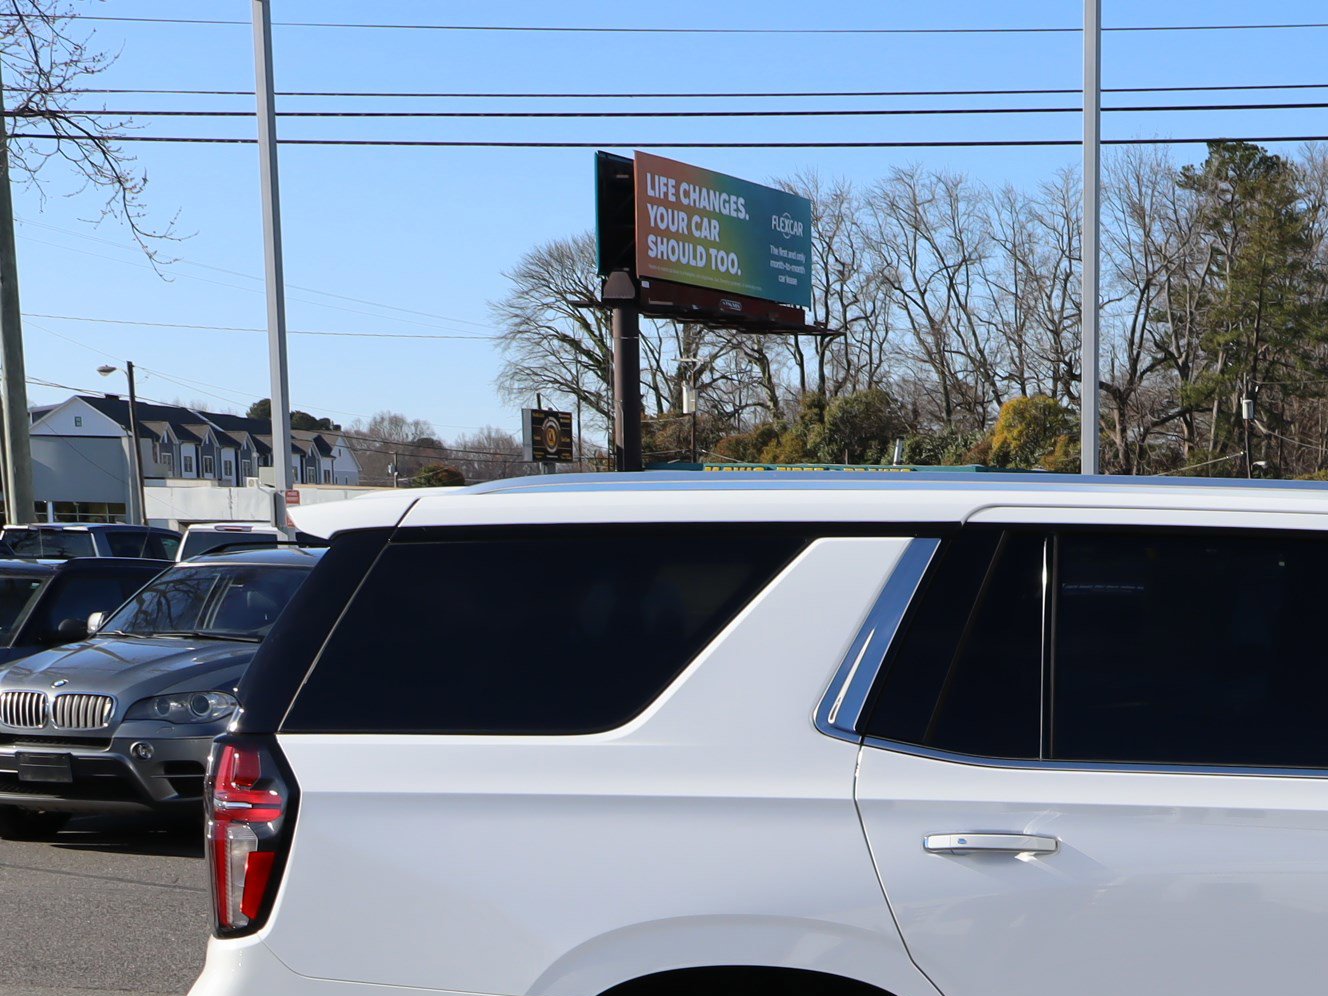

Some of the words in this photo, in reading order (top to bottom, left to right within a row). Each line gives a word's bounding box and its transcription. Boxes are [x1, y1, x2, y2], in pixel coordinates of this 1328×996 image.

[646, 172, 677, 202] LIFE
[680, 182, 750, 220] CHANGES.
[647, 203, 689, 235] YOUR
[691, 214, 720, 242] CAR
[771, 214, 804, 238] FLEXCAR
[647, 234, 707, 268] SHOULD
[709, 248, 742, 276] TOO.
